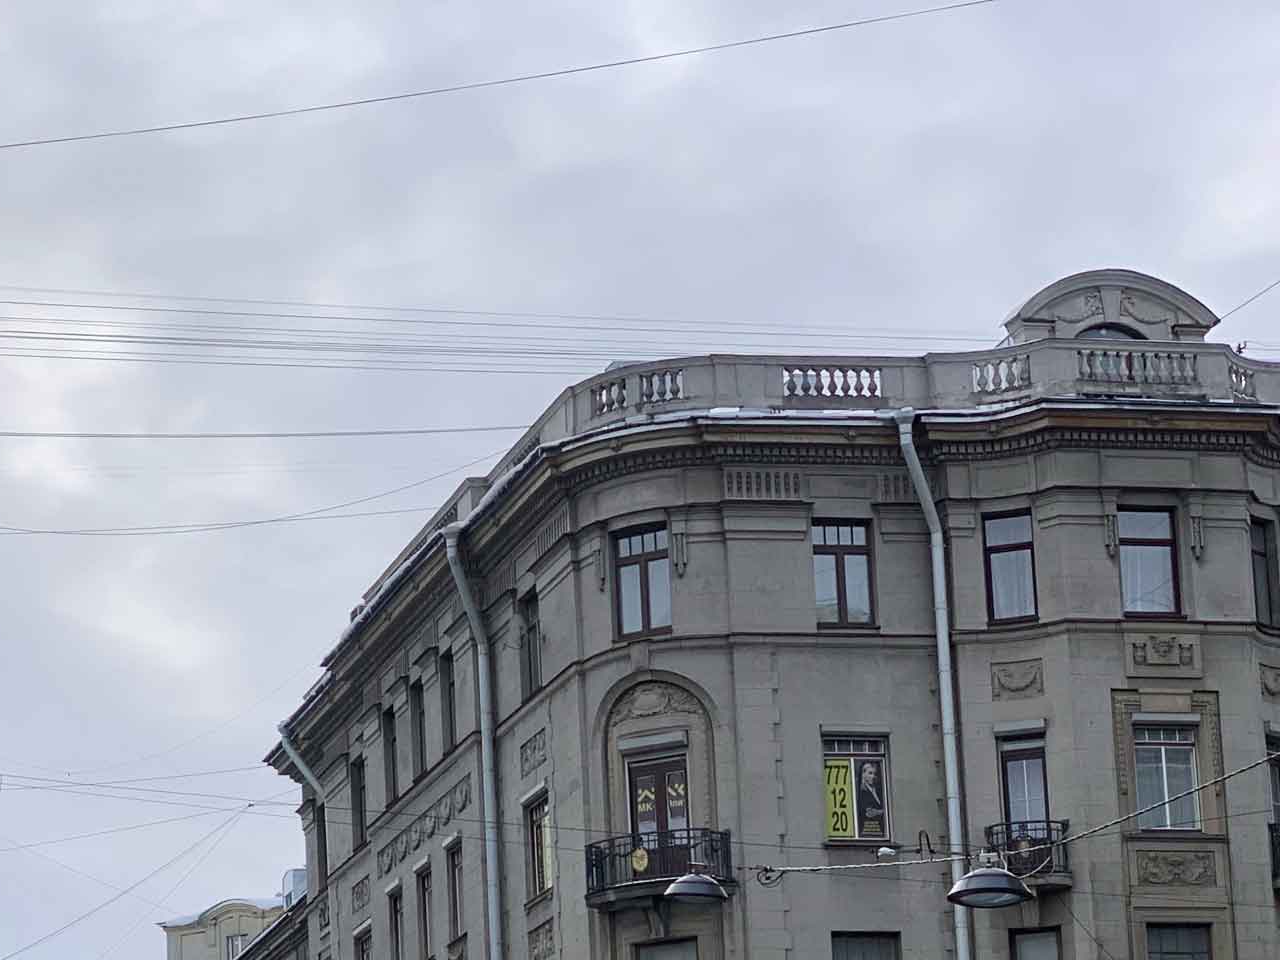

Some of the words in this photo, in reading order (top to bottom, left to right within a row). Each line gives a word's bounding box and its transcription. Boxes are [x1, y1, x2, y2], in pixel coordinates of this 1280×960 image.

[824, 764, 849, 785] 777
[831, 787, 847, 809] 12
[832, 811, 848, 832] 20
